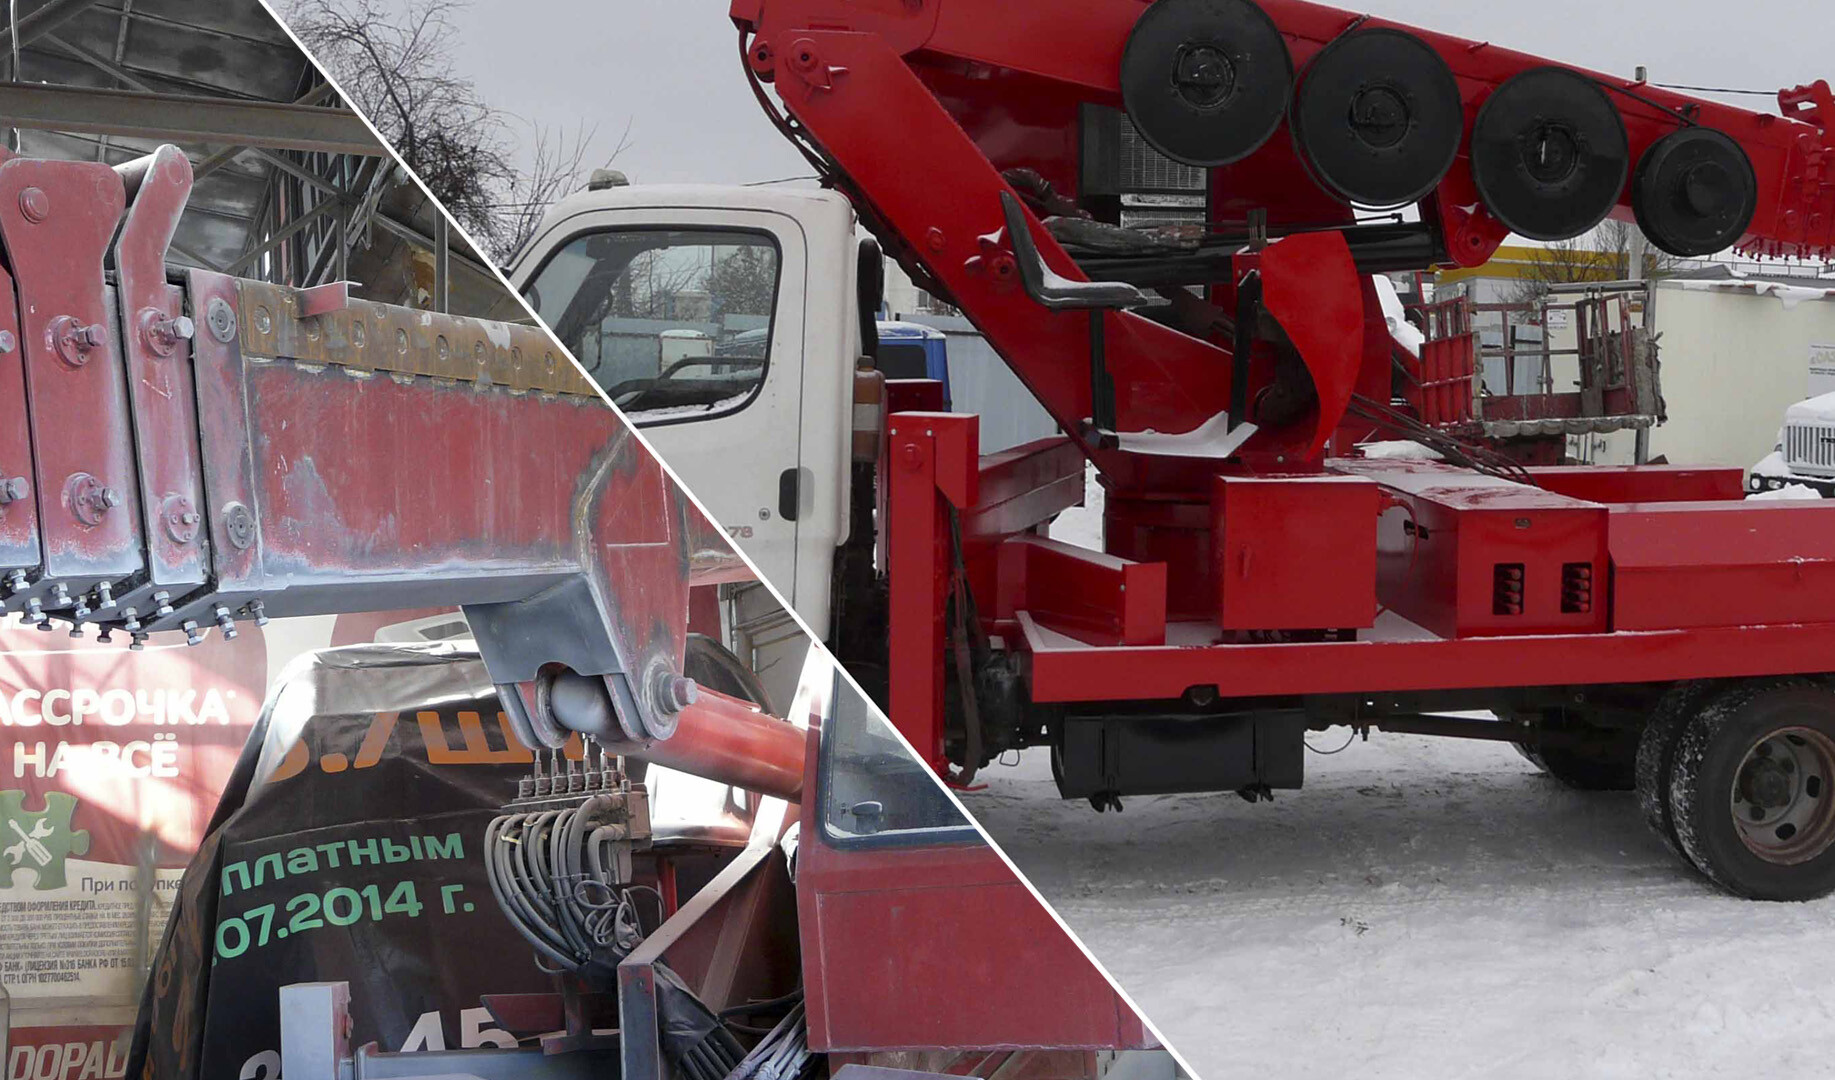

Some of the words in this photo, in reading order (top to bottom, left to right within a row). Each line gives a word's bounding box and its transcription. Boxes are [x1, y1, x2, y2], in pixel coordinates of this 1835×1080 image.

[722, 525, 753, 538] 78
[222, 833, 465, 897] платным
[82, 877, 115, 895] При
[119, 879, 184, 891] попке
[441, 884, 474, 914] г.
[78, 959, 98, 970] БАНКА
